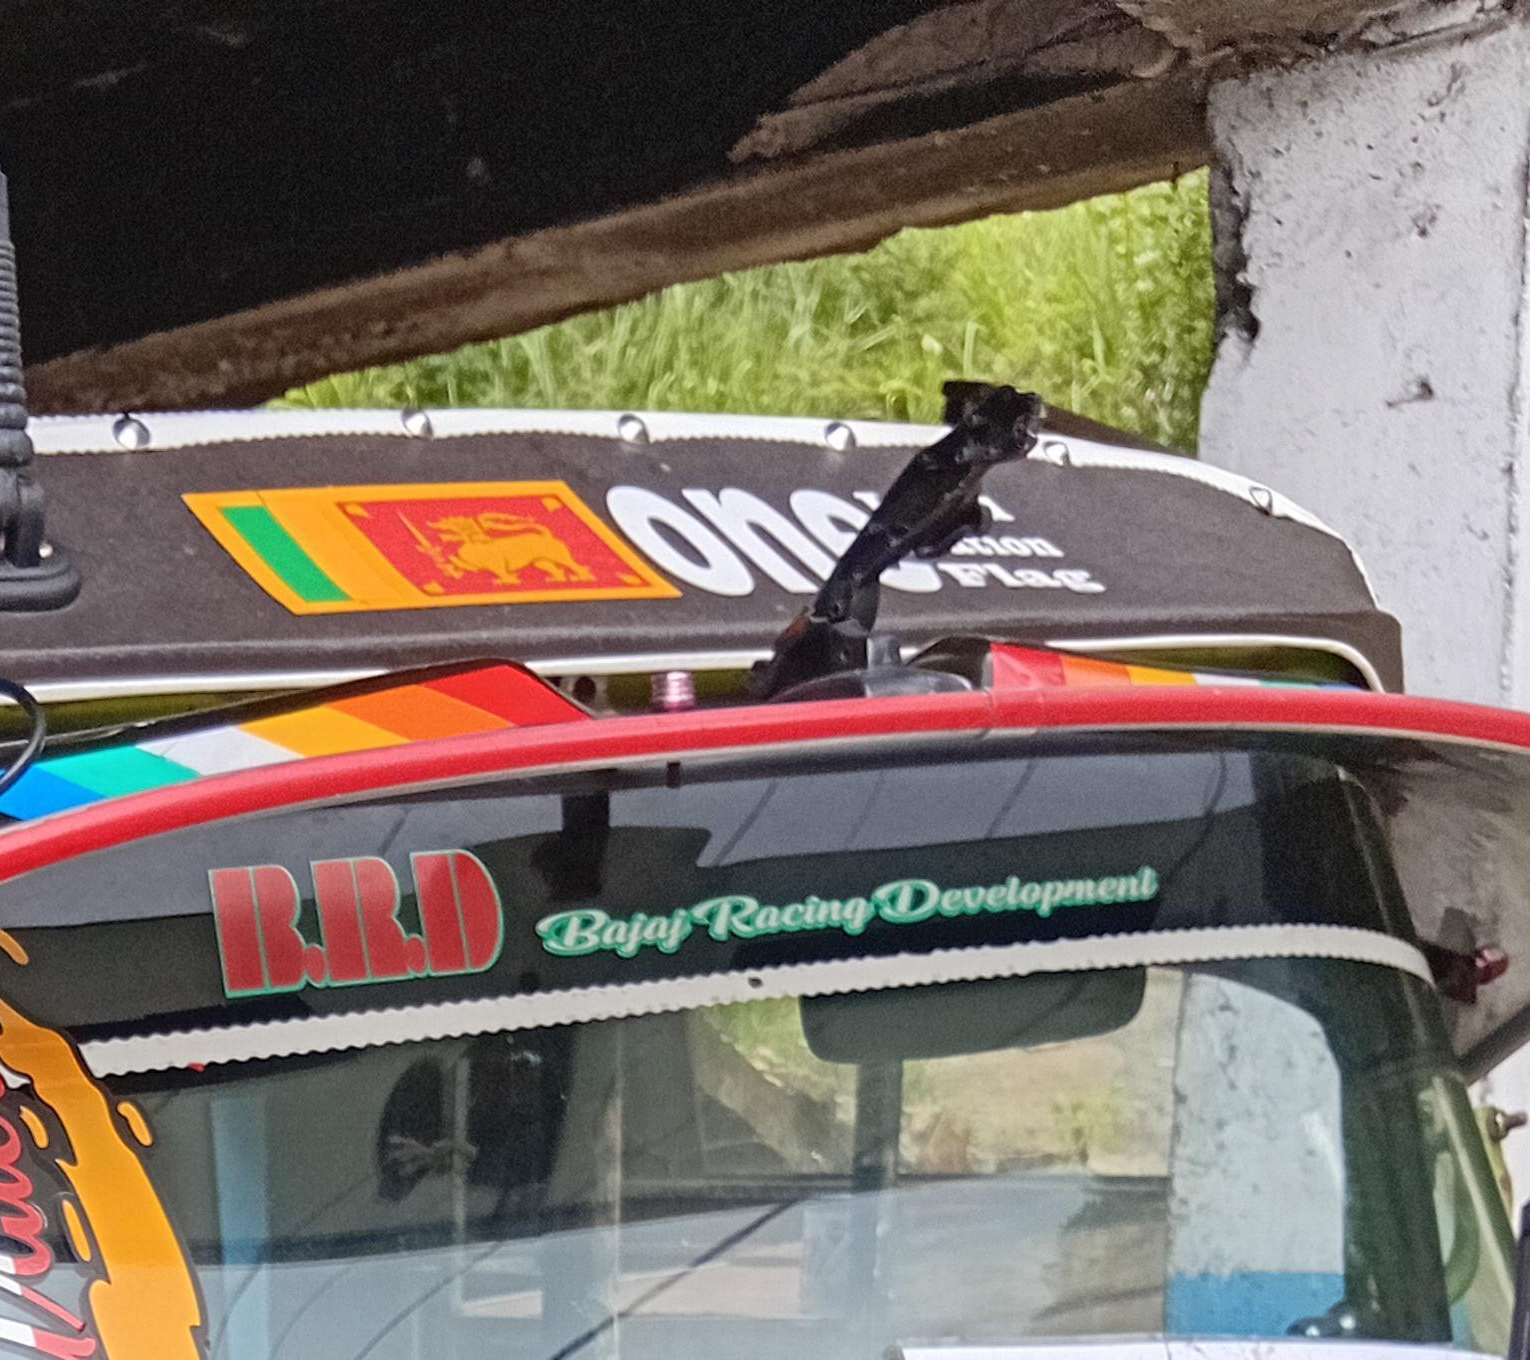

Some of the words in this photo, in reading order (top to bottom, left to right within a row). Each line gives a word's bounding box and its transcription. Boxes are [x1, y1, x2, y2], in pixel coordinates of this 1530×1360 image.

[536, 909, 694, 957] Bajaj
[692, 894, 872, 942] Racing
[870, 866, 1160, 924] Development
